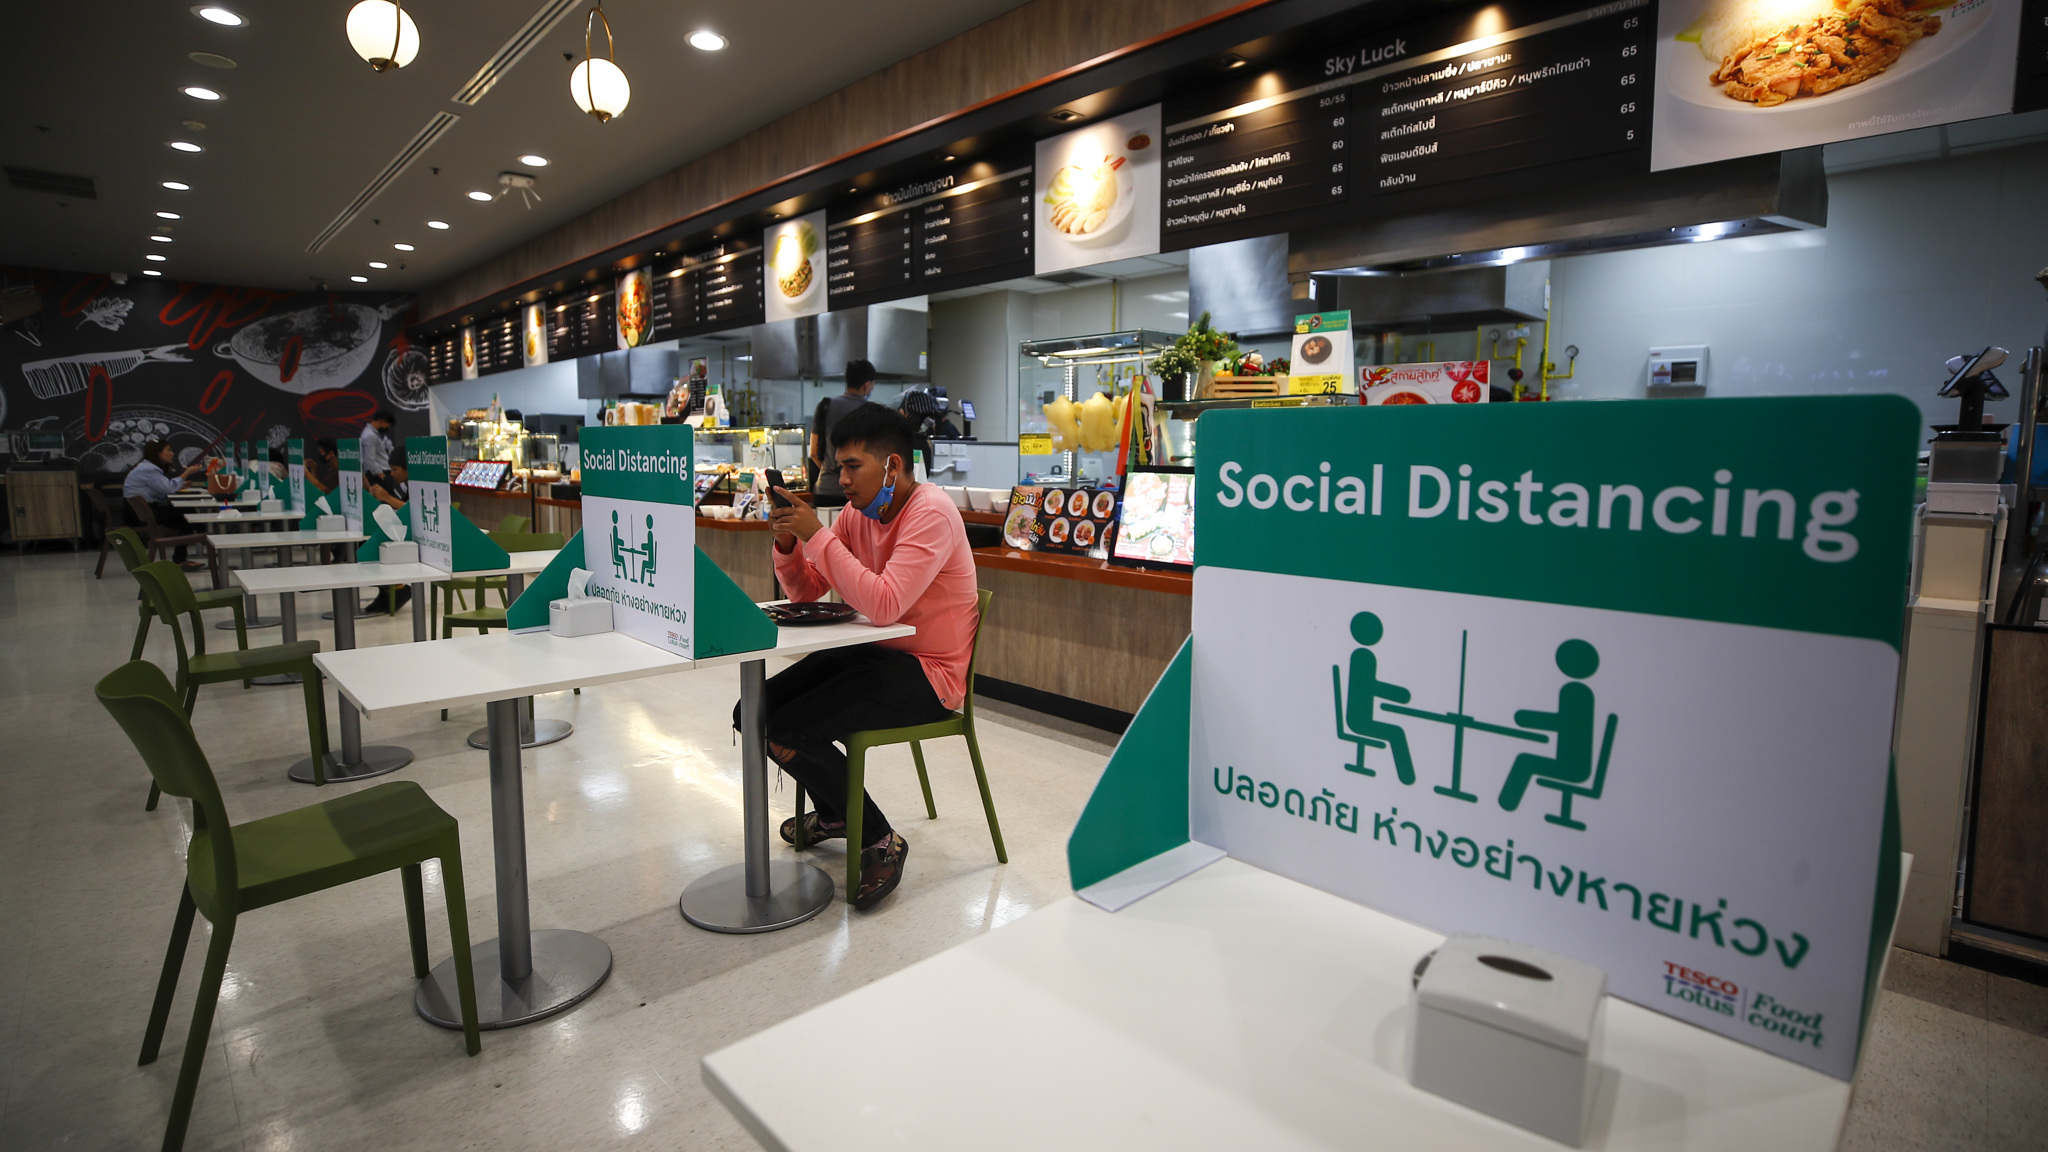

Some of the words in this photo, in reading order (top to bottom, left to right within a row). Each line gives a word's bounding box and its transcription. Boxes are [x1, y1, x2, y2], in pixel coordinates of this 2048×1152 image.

[1623, 17, 1638, 29] 65
[1325, 56, 1356, 76] Sky
[1361, 38, 1407, 67] Luck
[1622, 45, 1637, 57] 65
[1518, 56, 1591, 84] หมูพริกไทยดำ
[1620, 73, 1636, 86] 65
[1320, 94, 1346, 107] 50/55
[1620, 102, 1636, 114] 65
[1333, 117, 1345, 127] 60
[1380, 116, 1437, 140] สเต็กไก่สไปซี่
[1627, 130, 1634, 140] 5
[1332, 140, 1344, 150] 60
[1332, 163, 1344, 173] 65
[1380, 173, 1416, 188] กลับบ้าน
[883, 175, 954, 206] ข้าวมันไก่กาญจนา
[1331, 186, 1343, 196] 65
[1323, 381, 1337, 394] 25
[407, 451, 421, 465] Social
[422, 450, 446, 469] Distancing
[584, 449, 615, 471] Social
[618, 449, 688, 481] Distancing
[1216, 460, 1384, 516] Social
[1407, 464, 1861, 563] Distancing
[592, 582, 620, 604] ปลอดภัย
[621, 589, 687, 625] ห่างอย่างหายห่วง
[1214, 766, 1358, 834] ปลอดภัย
[1373, 806, 1811, 970] ห่างอย่างหายห่วง
[1663, 960, 1739, 996] TESCO
[1665, 979, 1736, 1017] Lotus
[1751, 991, 1824, 1030] Food
[1748, 1012, 1824, 1049] court
